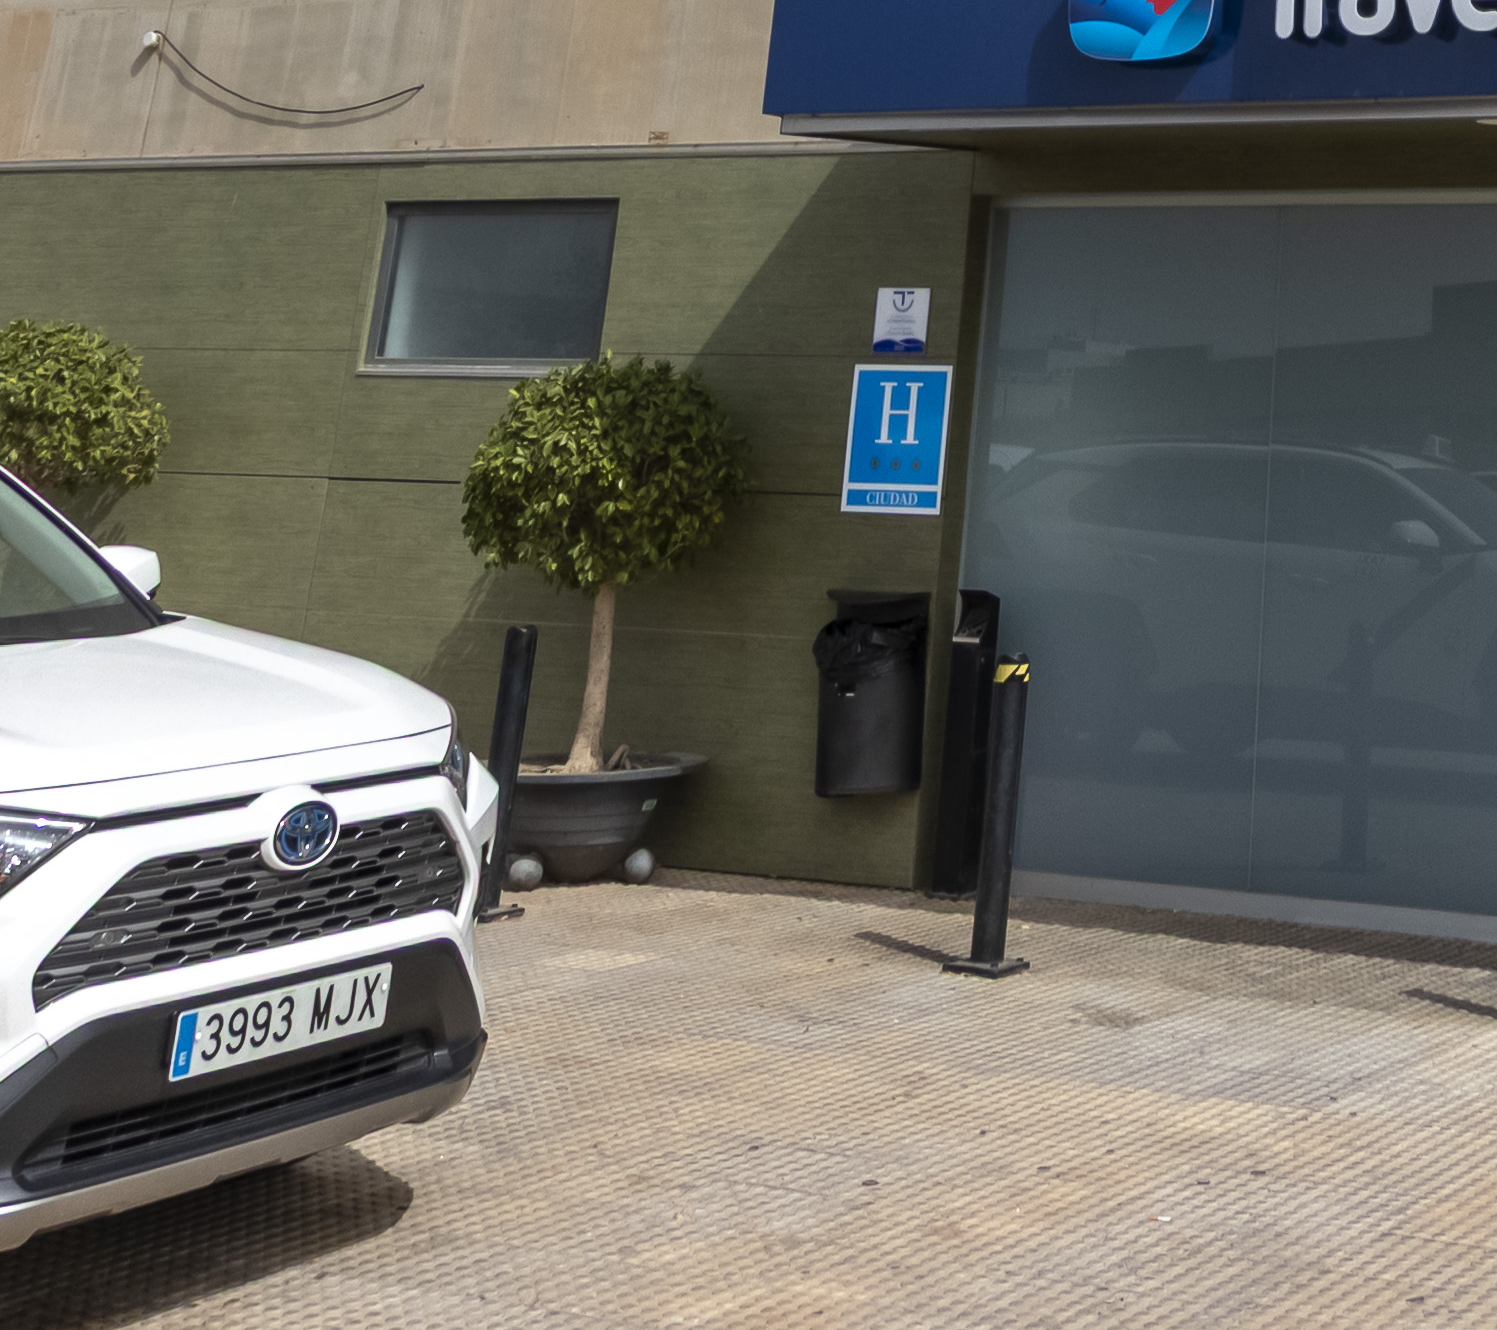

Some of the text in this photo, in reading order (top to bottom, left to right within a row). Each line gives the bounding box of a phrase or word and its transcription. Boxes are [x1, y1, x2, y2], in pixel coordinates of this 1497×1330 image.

[875, 382, 924, 444] H
[866, 492, 918, 506] CIUDAD
[201, 973, 382, 1061] 3993 MJX
[178, 1051, 187, 1066] E
